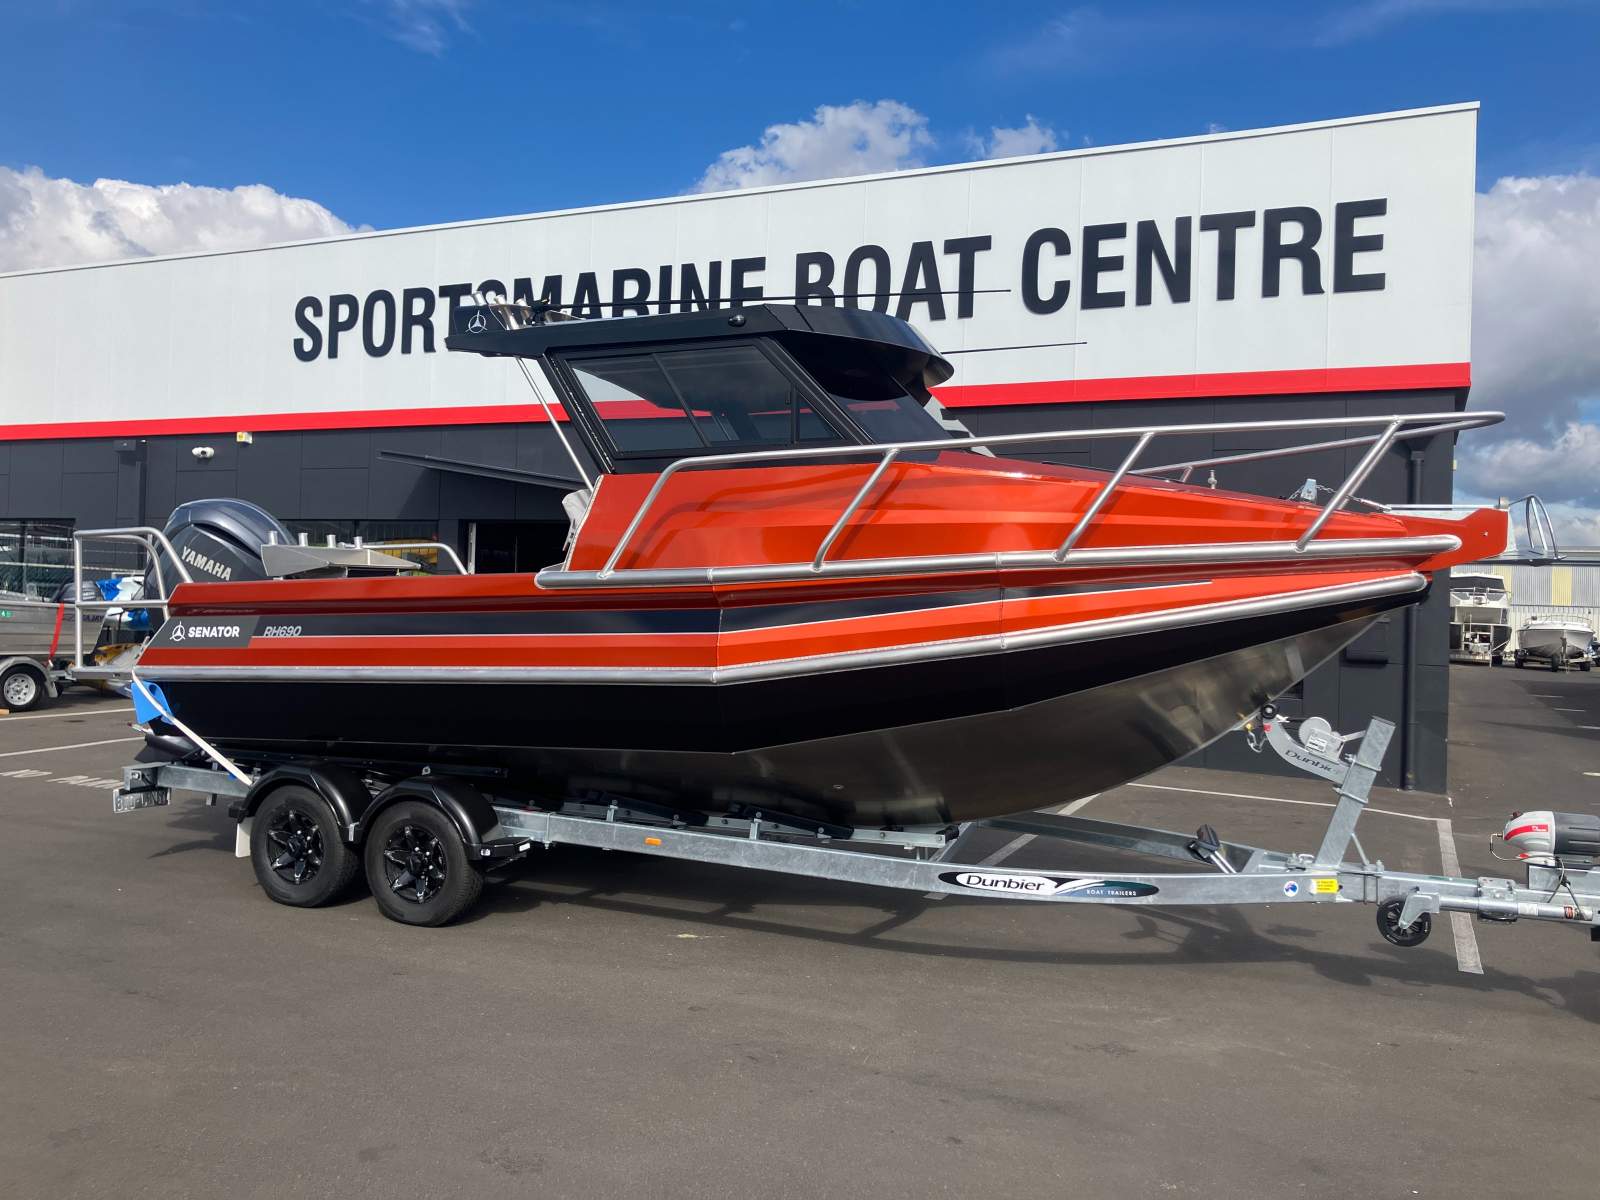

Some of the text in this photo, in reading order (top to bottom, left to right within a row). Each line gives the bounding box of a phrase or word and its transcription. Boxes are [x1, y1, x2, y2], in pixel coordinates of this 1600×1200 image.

[795, 235, 992, 322] BOAT
[1021, 197, 1388, 316] CENTRE
[181, 546, 232, 581] YAMAHA
[188, 625, 302, 638] SENATOR RH690
[966, 874, 1045, 892] Dunbier
